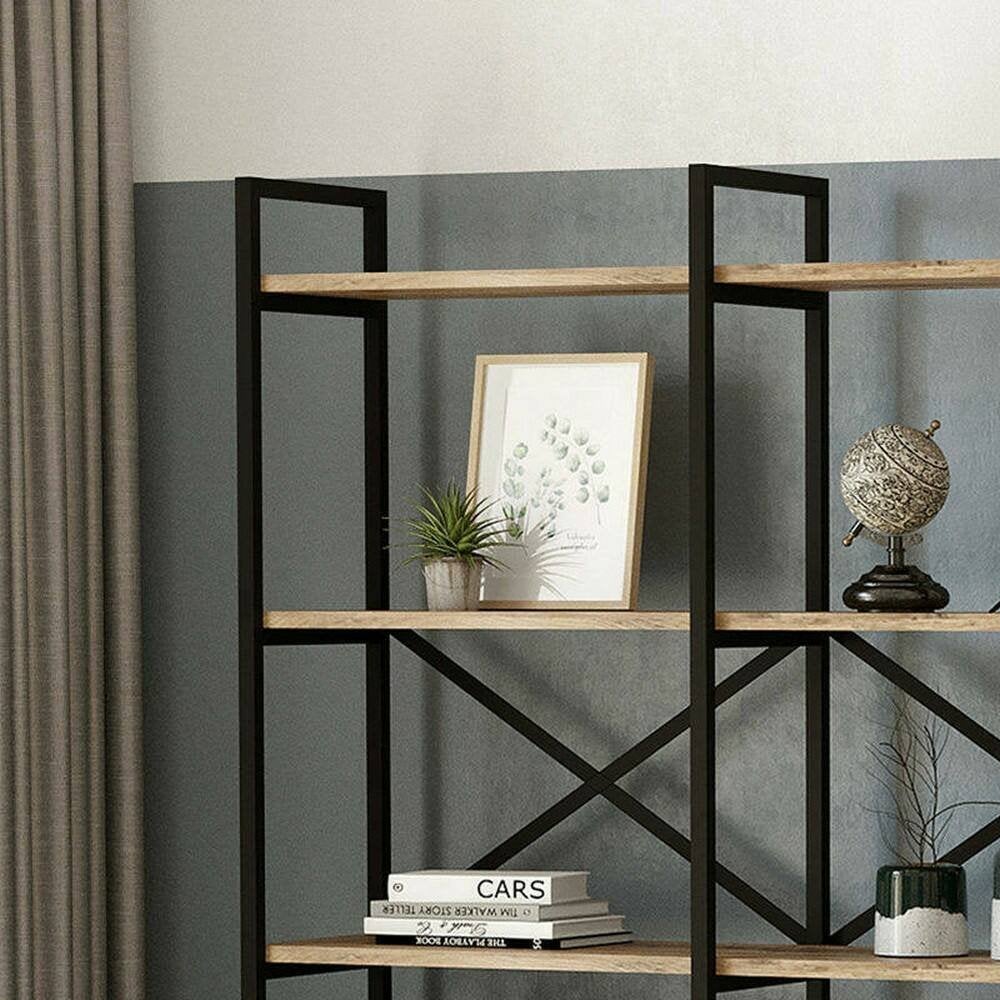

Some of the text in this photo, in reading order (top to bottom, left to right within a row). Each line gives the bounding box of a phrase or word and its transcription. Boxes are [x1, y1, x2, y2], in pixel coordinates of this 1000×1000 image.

[477, 880, 545, 899] CARS
[382, 905, 518, 917] TIM WALKER STORY TELLER
[416, 937, 507, 946] THE PLAYBOY BOOK
